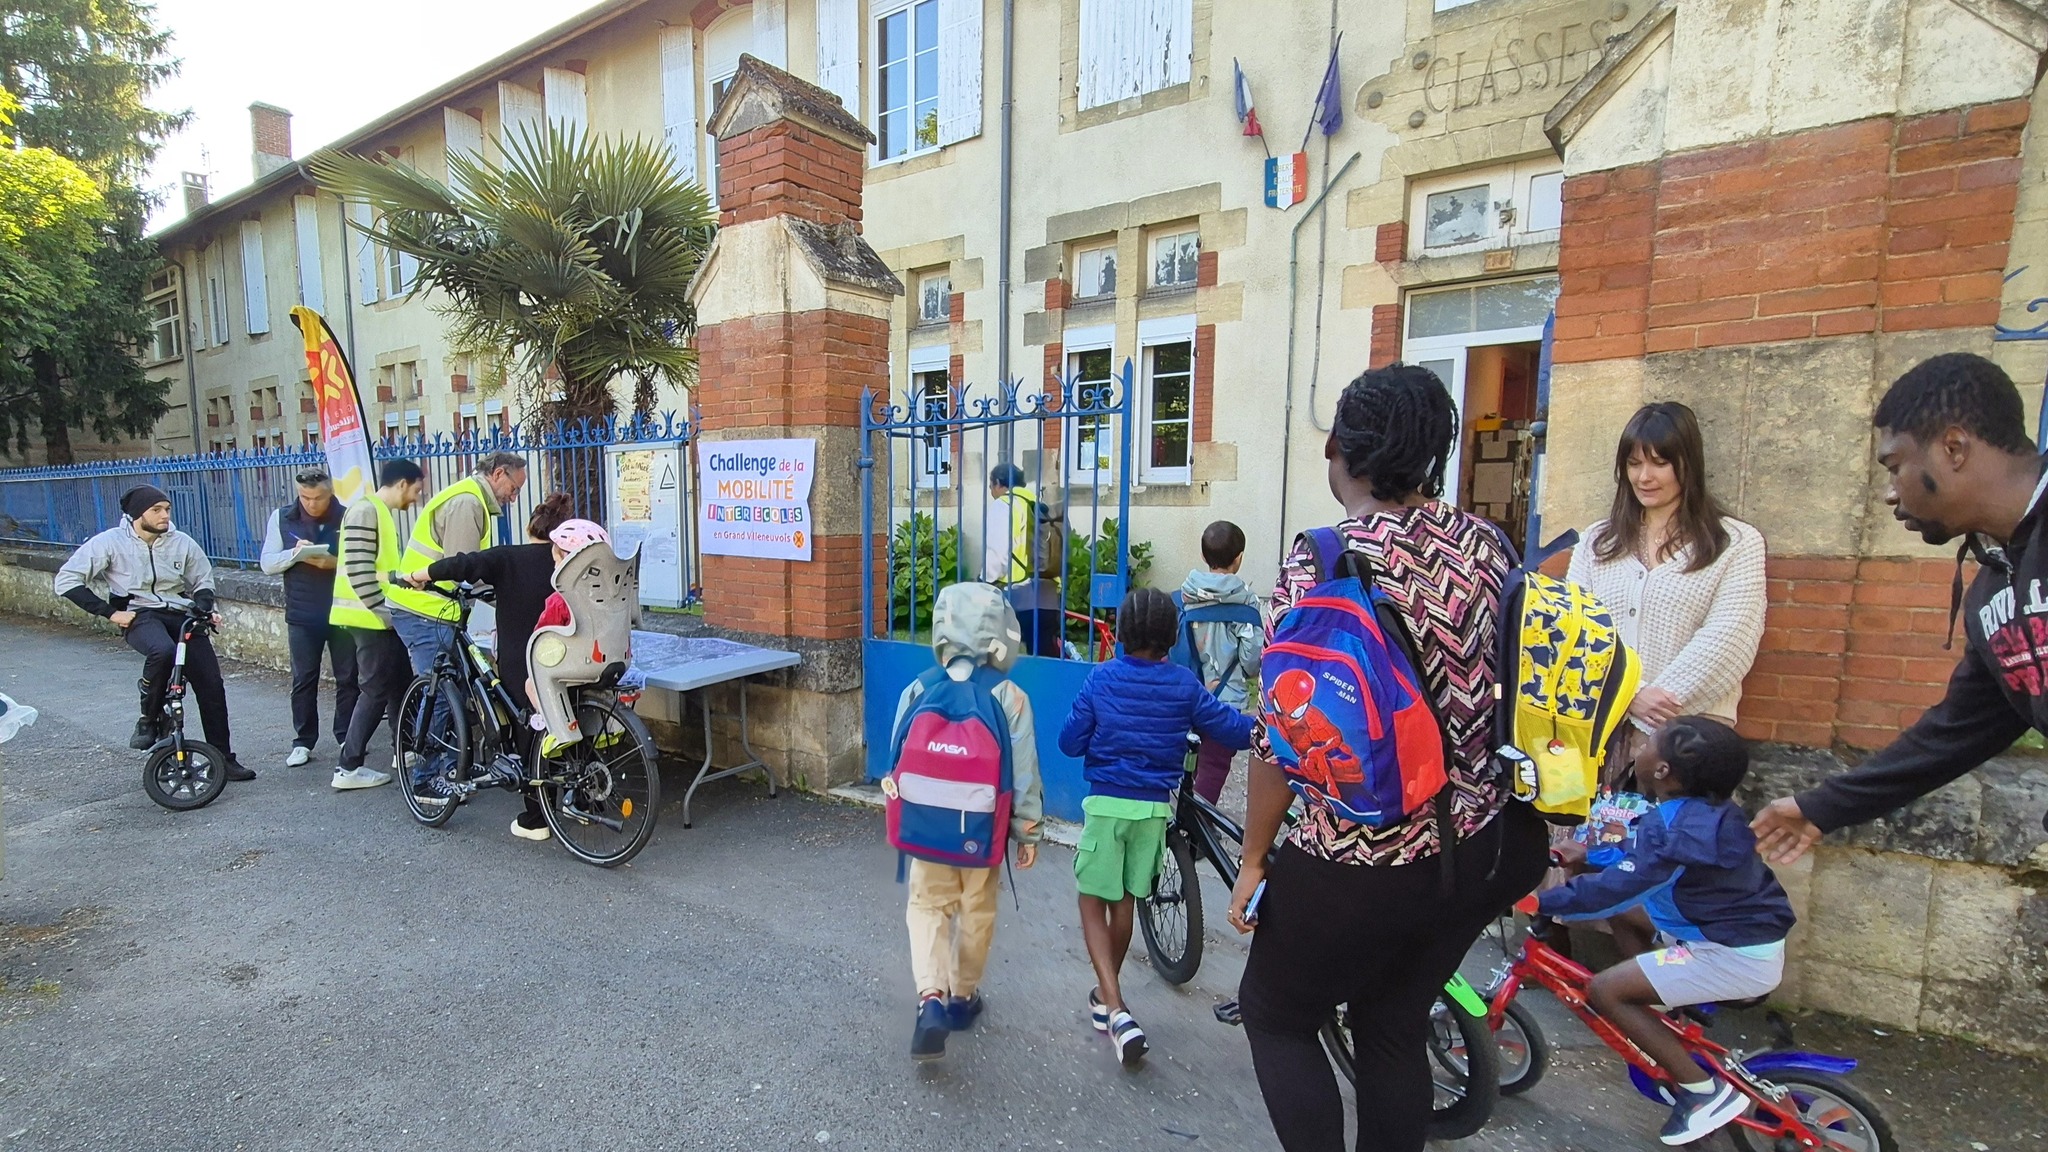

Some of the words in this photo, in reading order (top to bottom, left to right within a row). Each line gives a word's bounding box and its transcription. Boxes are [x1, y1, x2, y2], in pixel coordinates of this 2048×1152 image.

[1424, 19, 1612, 113] CLASSES
[709, 453, 777, 476] Challenge
[779, 459, 791, 472] de
[793, 459, 804, 472] la
[718, 473, 794, 500] MOBILITÉ
[707, 503, 751, 522] INTER
[713, 531, 722, 539] en
[723, 530, 746, 540] Grand
[746, 531, 791, 543] Villeneuvois
[1322, 671, 1355, 692] SPIDER
[927, 741, 968, 756] NASA
